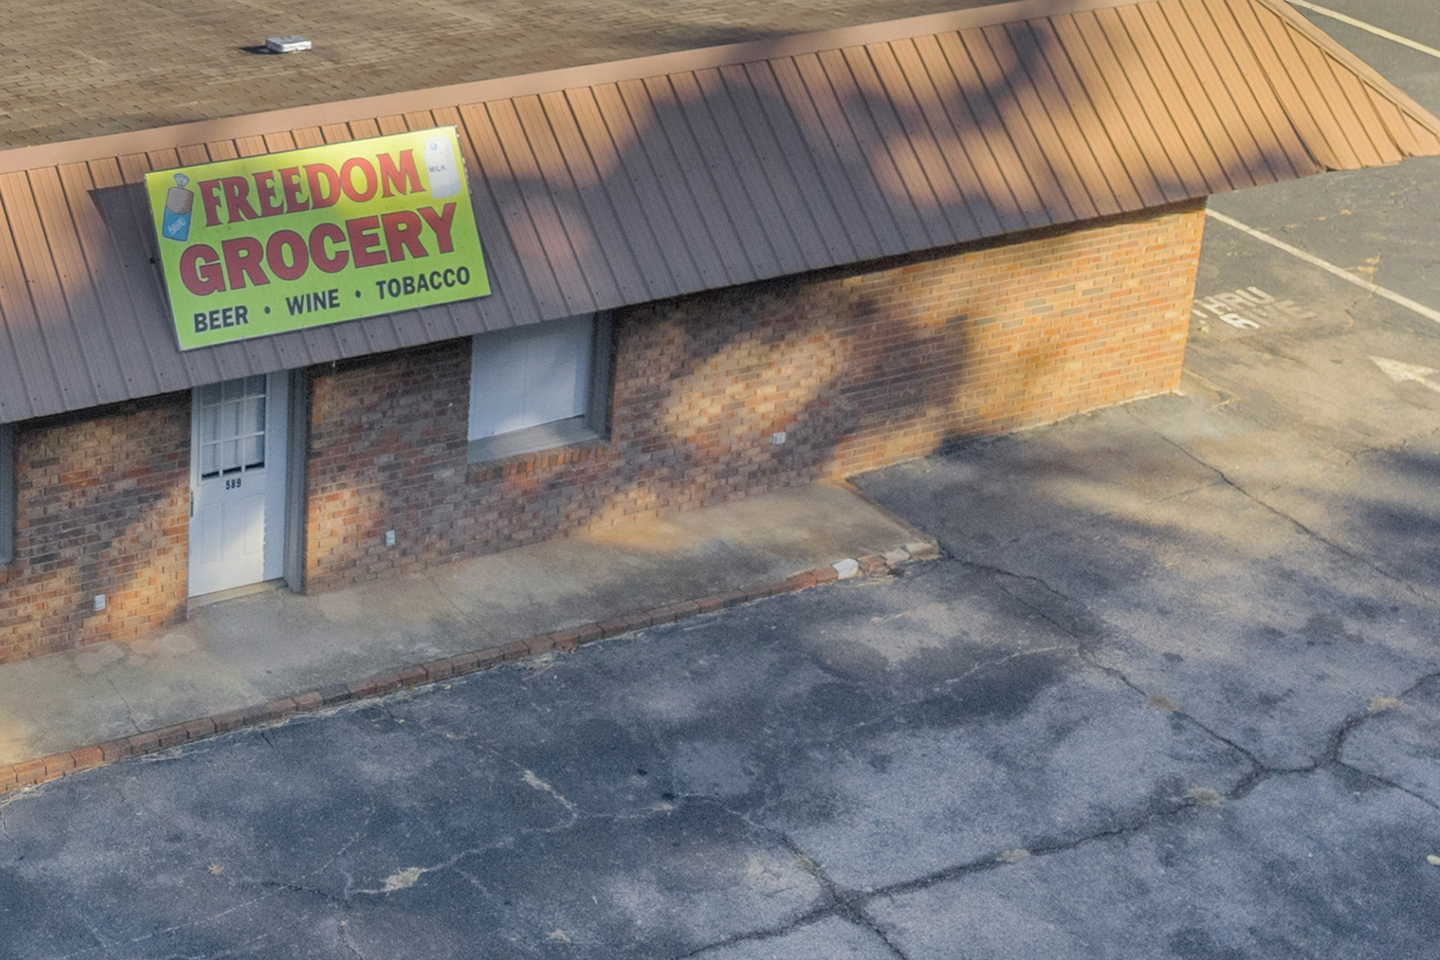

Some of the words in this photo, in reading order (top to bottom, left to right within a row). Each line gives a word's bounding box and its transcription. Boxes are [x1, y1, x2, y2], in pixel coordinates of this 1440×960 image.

[197, 149, 426, 227] FREEDOM
[179, 202, 458, 297] GROCERY
[193, 305, 249, 334] BEER
[285, 288, 340, 316] WINE
[376, 266, 470, 300] TOBACCO
[225, 478, 242, 490] 589
